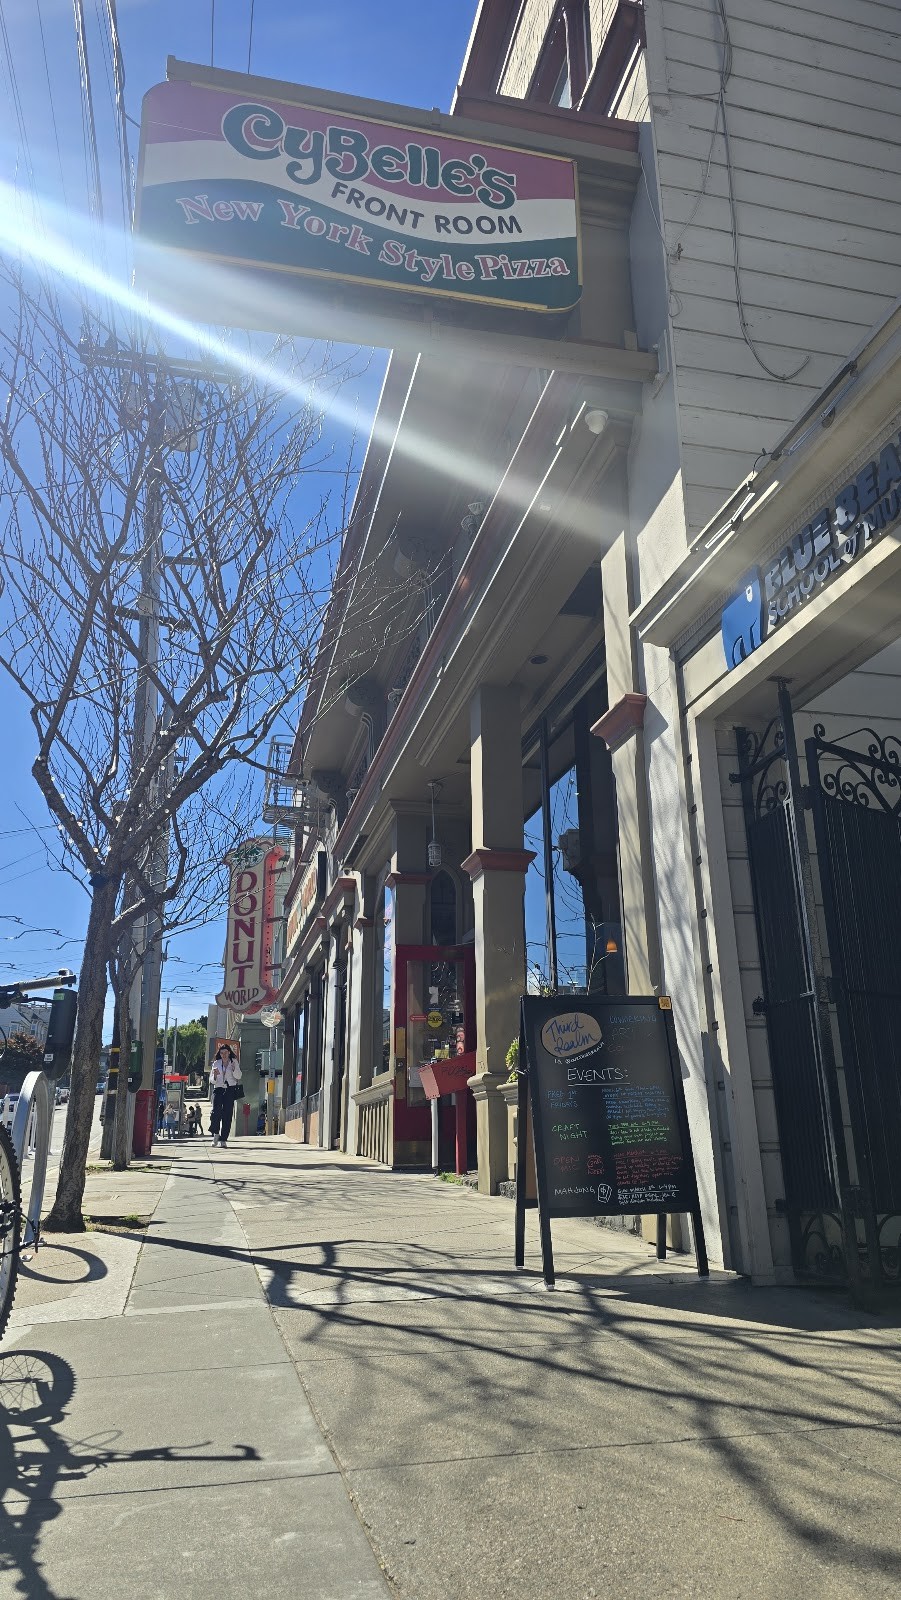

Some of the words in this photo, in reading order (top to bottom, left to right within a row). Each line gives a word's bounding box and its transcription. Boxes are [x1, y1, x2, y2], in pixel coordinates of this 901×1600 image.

[331, 182, 424, 229] FRONT
[434, 214, 523, 235] ROOM
[176, 194, 264, 224] New
[277, 199, 373, 255] York
[378, 239, 475, 282] Style
[474, 254, 571, 281] Pizza
[765, 507, 831, 602] BLUE
[834, 431, 901, 533] BEA
[768, 547, 840, 624] SCHOOL
[863, 484, 901, 540] MU
[230, 870, 258, 989] DONUT
[224, 987, 259, 1006] WORLD
[545, 1013, 585, 1043] Third
[554, 1029, 599, 1056] Realm
[551, 1123, 580, 1132] CRAFT
[559, 1130, 588, 1141] NIGHT
